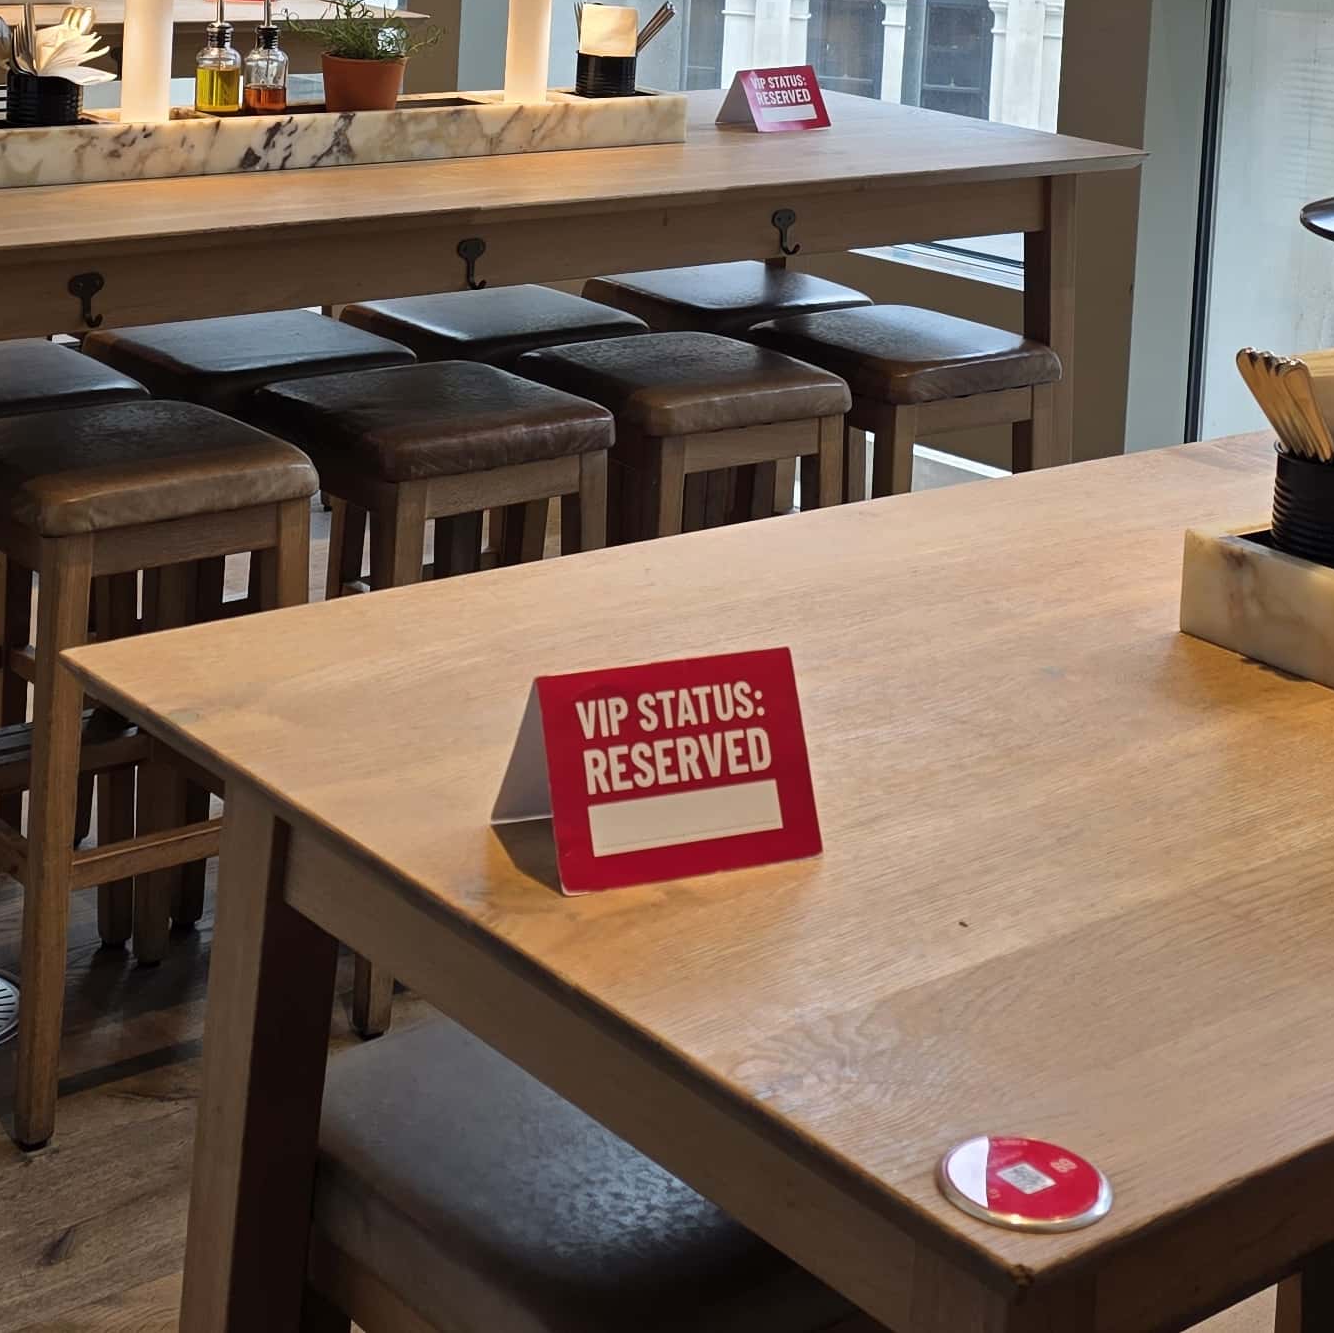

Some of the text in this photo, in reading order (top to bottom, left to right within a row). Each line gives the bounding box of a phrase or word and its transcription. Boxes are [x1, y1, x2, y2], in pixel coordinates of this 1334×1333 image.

[750, 74, 807, 90] VIP STATUS:
[755, 88, 811, 106] RESERVED
[575, 680, 766, 740] VIP STATUS:
[582, 726, 773, 796] RESERVED
